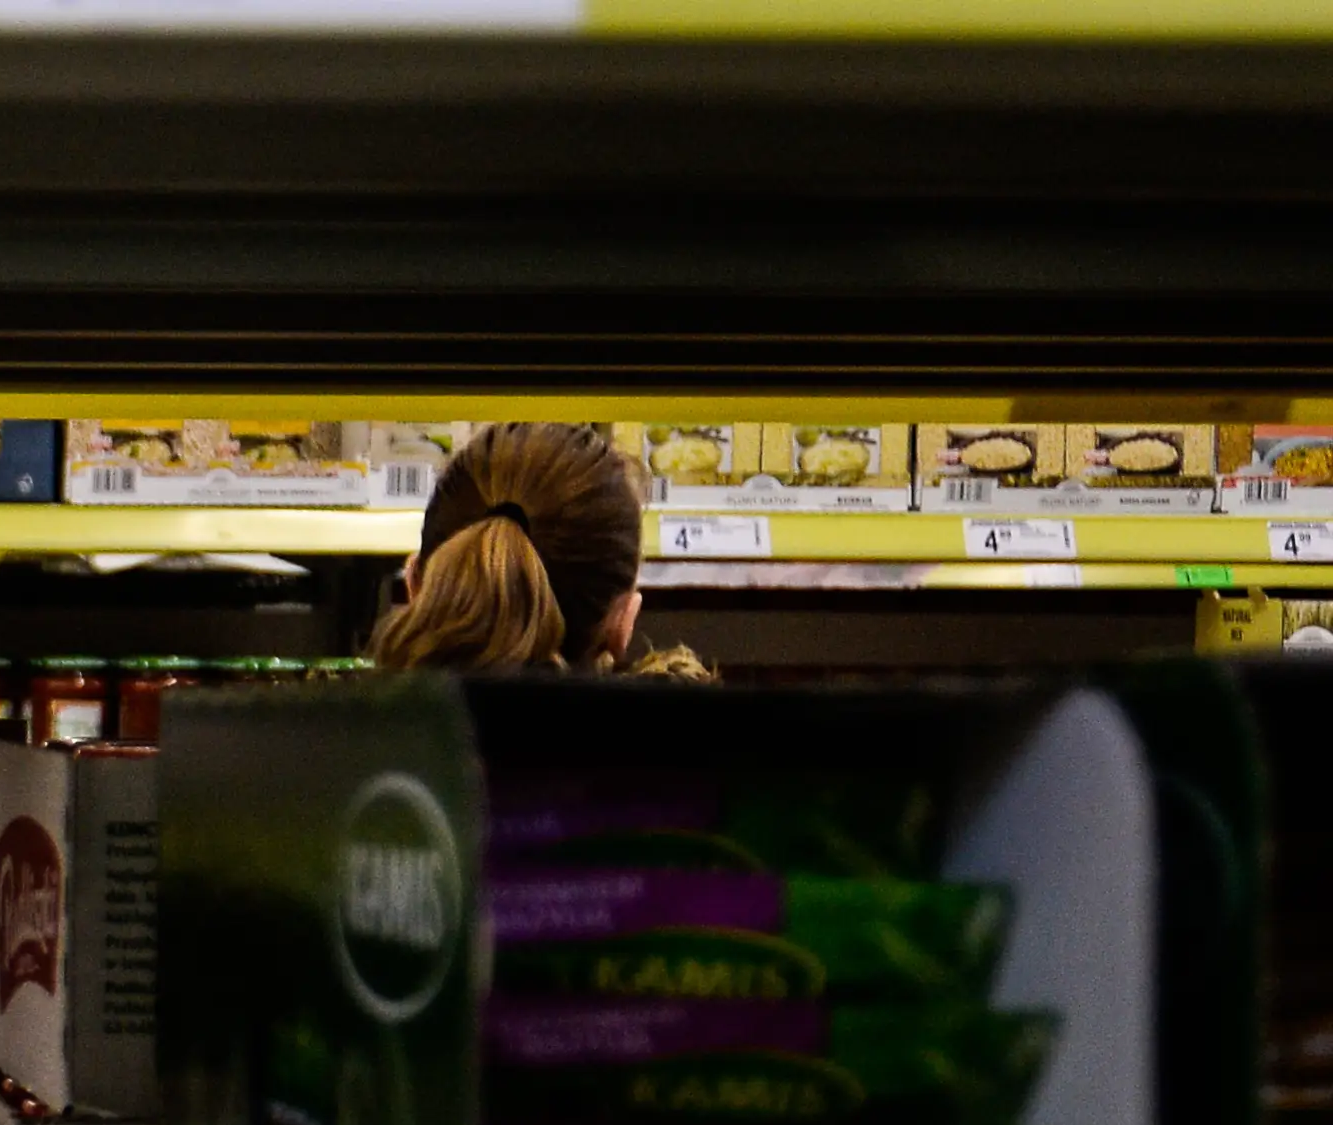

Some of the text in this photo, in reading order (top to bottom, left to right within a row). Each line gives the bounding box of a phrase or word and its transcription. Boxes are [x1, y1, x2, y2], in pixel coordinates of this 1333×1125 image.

[675, 527, 688, 549] 4
[984, 531, 998, 553] 4
[1284, 533, 1299, 555] 4
